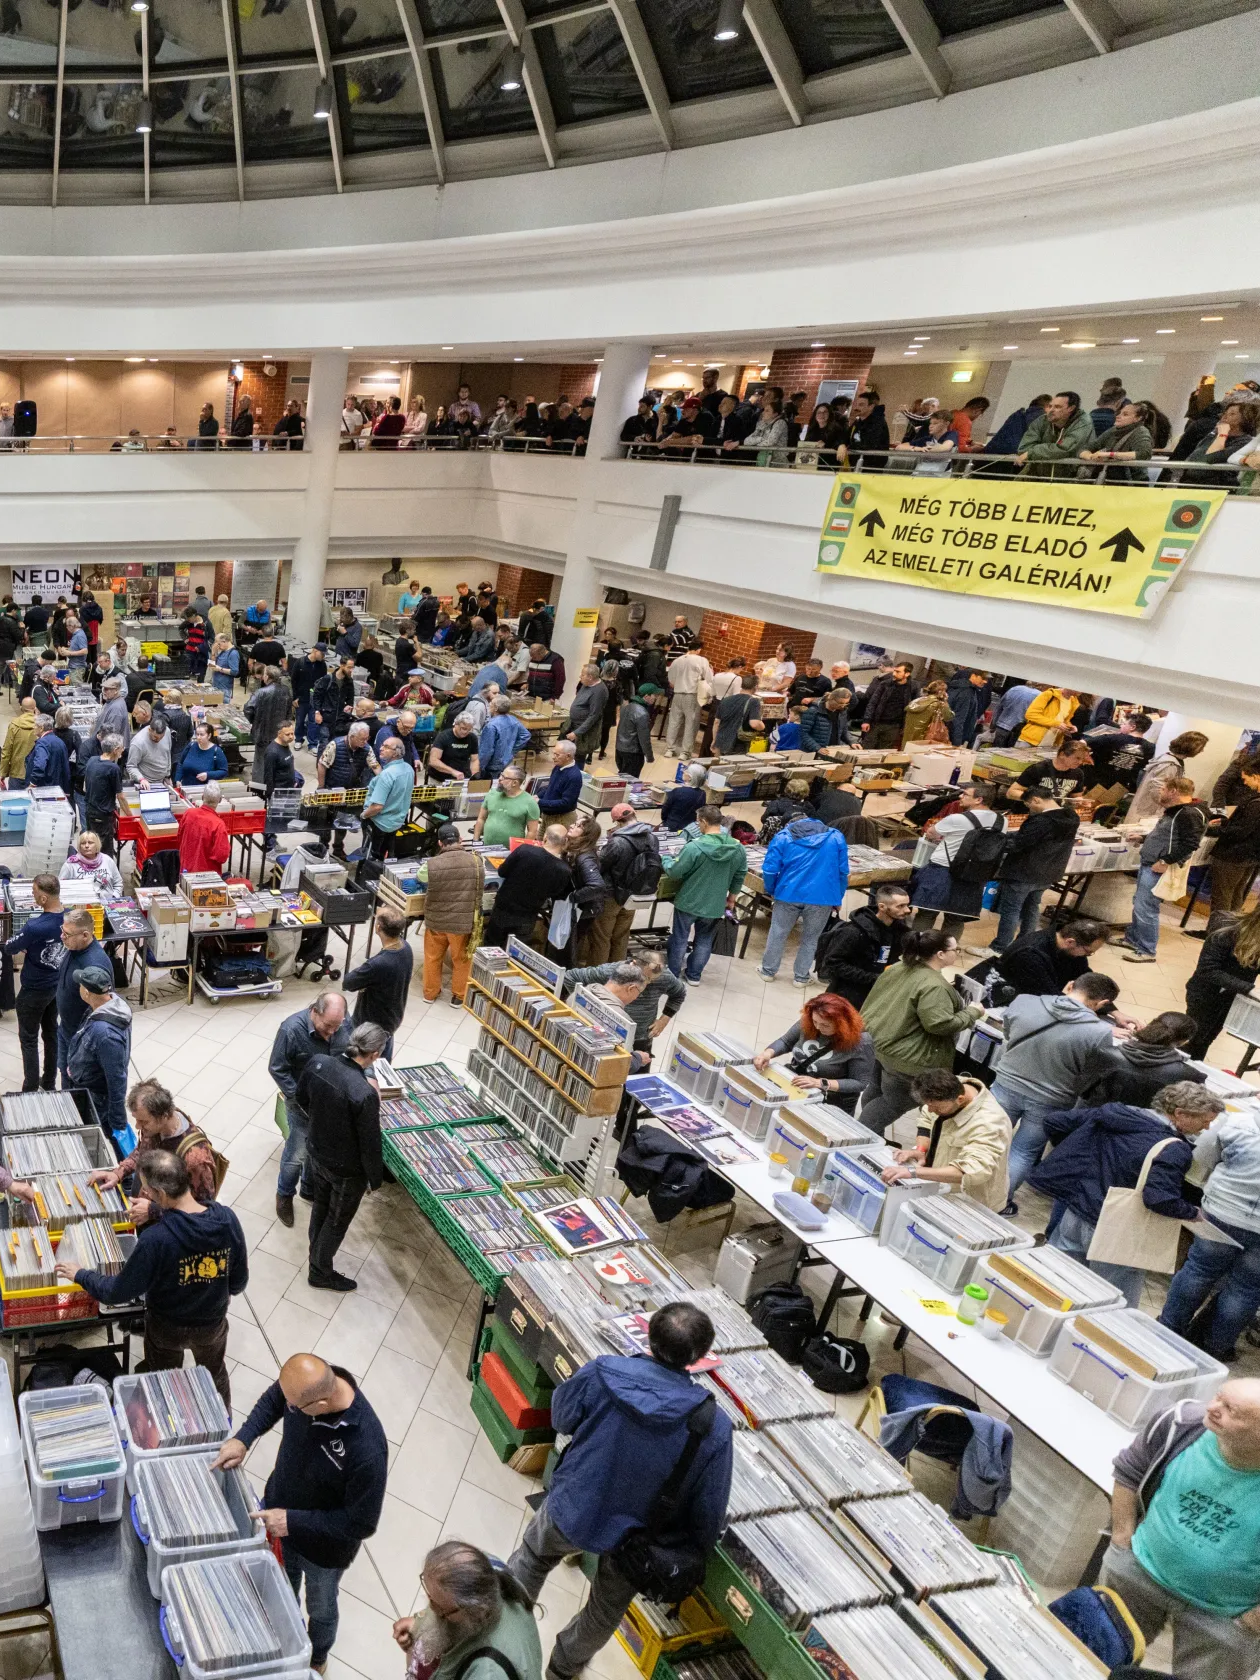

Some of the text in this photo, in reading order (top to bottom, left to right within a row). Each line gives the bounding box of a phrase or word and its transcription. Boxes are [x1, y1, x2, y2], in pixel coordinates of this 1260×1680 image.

[899, 497, 1098, 532] MÉG TÖBB LEMEZ,
[891, 524, 1088, 559] MÉG TÖBB ELADÓ
[12, 569, 78, 584] NEON
[863, 548, 1112, 594] AZ EMELETI GALÉRIÁN!
[624, 1262, 642, 1279] STAR
[1179, 1494, 1240, 1529] TOO OLD
[1186, 1489, 1236, 1515] NEVER
[1179, 1504, 1229, 1535] TO DIE
[1179, 1516, 1220, 1542] YOUNG
